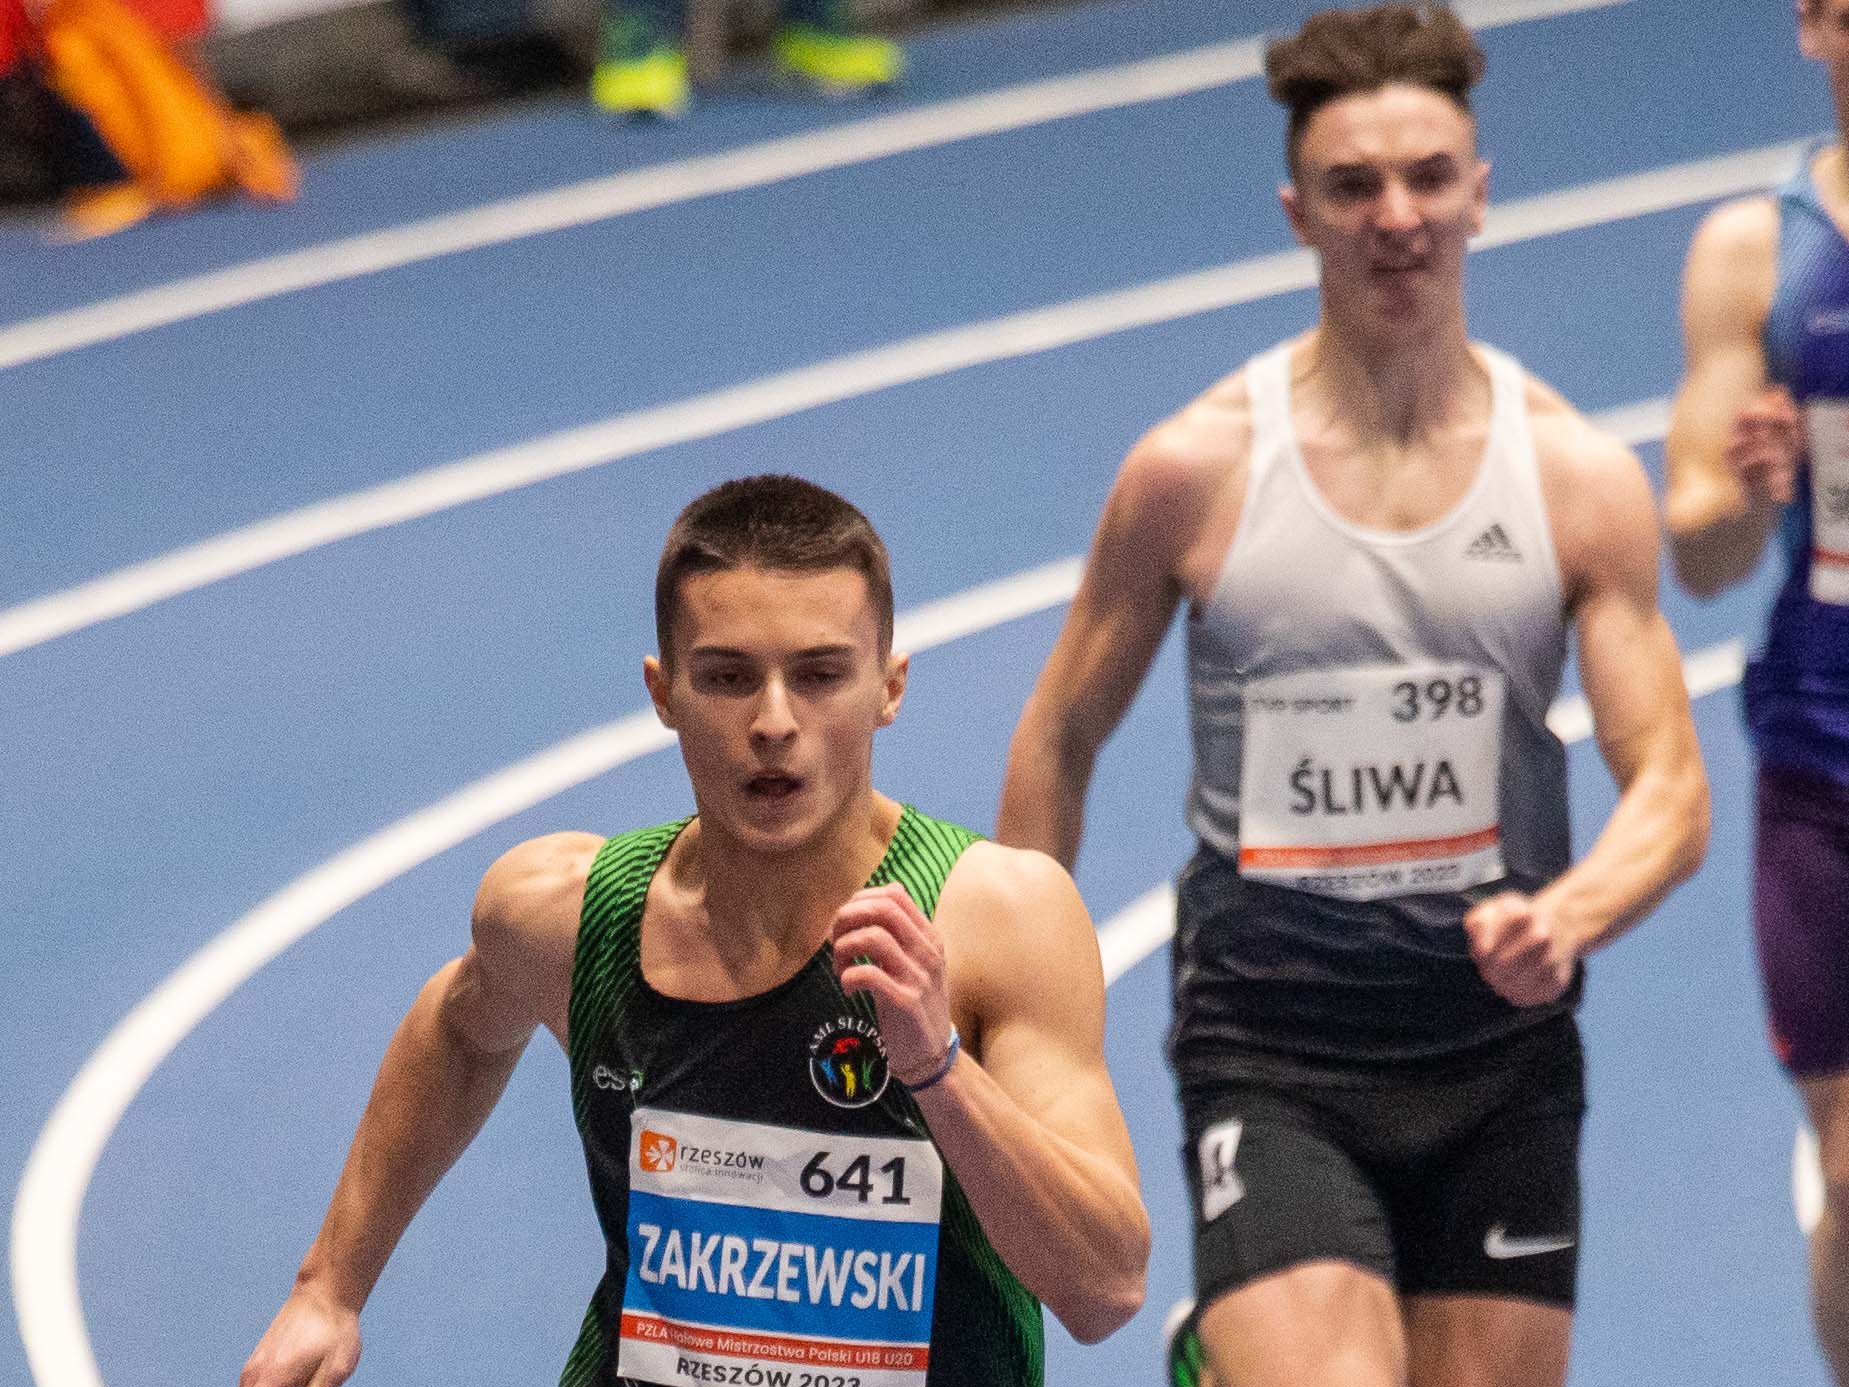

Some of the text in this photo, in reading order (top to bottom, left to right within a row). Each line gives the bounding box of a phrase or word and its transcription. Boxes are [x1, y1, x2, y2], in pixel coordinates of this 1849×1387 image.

[1392, 675, 1483, 722] 398
[1288, 757, 1464, 816] ŚLIWA
[680, 1146, 765, 1170] rzeszów
[800, 1151, 911, 1206] 641
[638, 1224, 926, 1312] ZAKRZEWSKI
[636, 1322, 669, 1339] PZLA
[717, 1338, 805, 1359] Mistrzostwa
[809, 1347, 851, 1363] Polski
[855, 1351, 881, 1365] U18
[884, 1353, 914, 1366] U20
